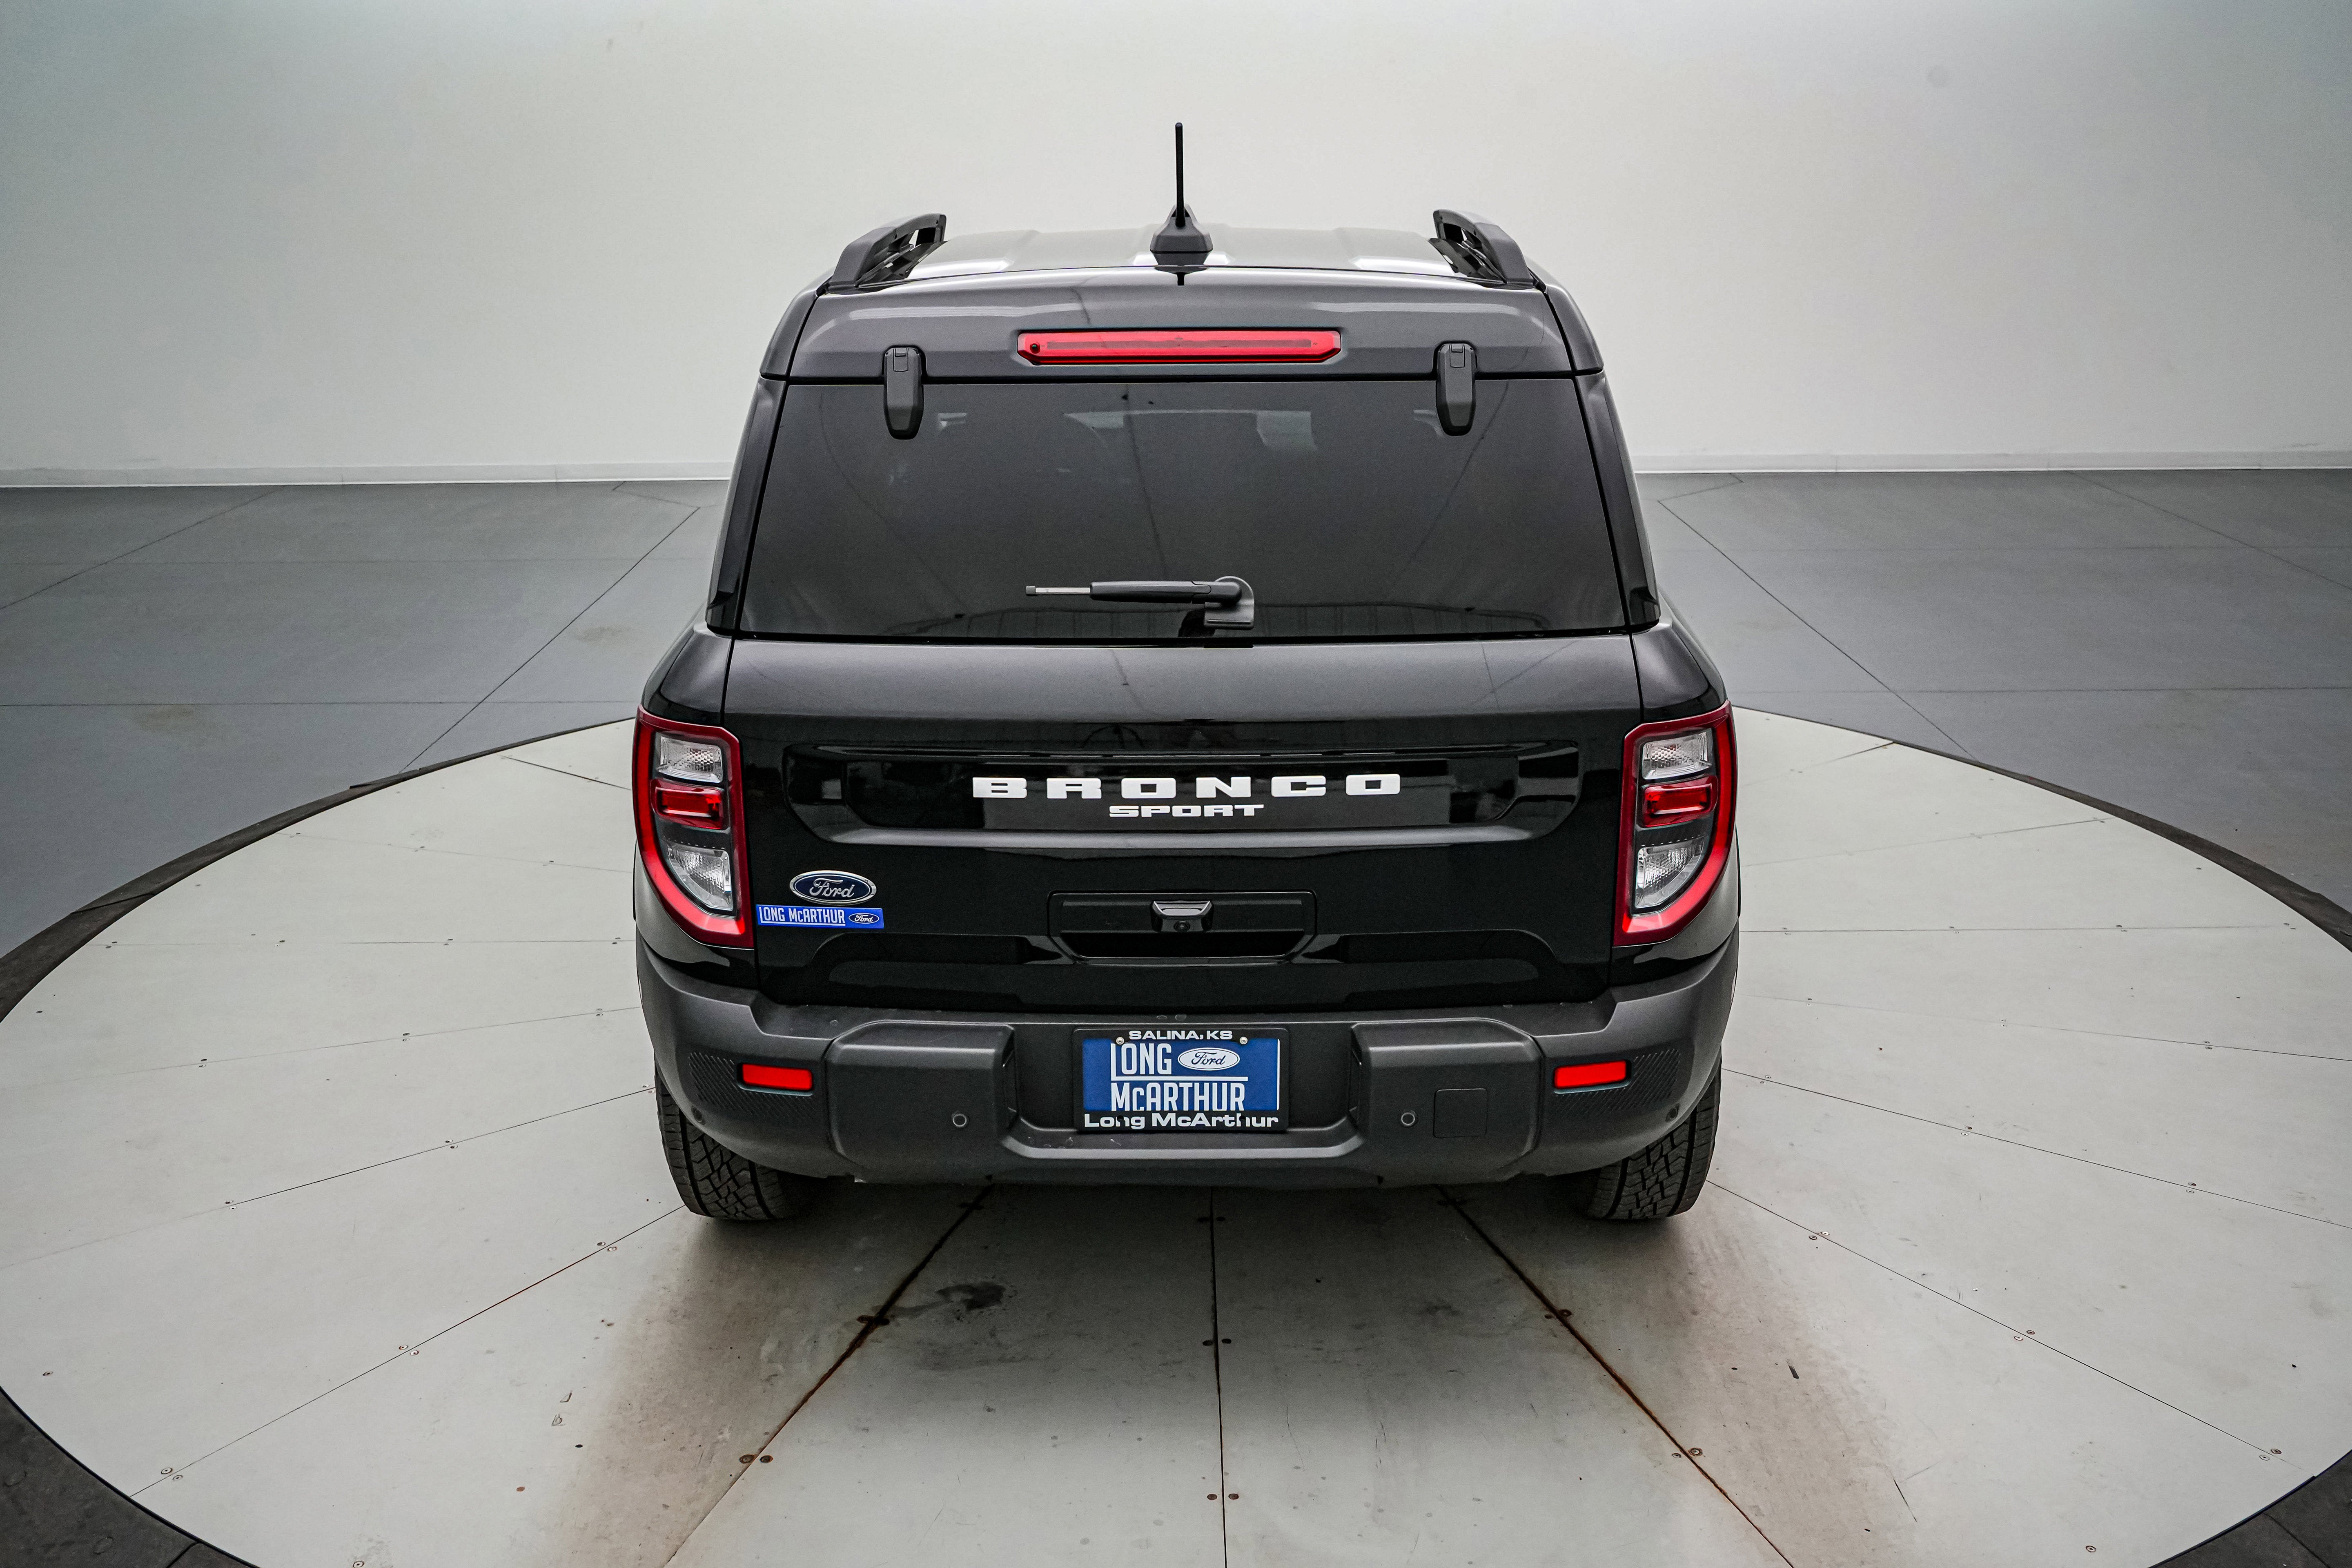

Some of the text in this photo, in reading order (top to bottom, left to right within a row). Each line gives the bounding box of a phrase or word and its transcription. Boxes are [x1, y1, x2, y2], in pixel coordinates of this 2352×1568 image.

[973, 774, 1400, 799] BRONCO
[1109, 804, 1264, 817] SPORT
[809, 878, 855, 898] Ford
[759, 906, 845, 924] LONG McARTHUR
[854, 914, 873, 922] Ford
[1110, 1043, 1172, 1080] LONG
[1191, 1051, 1226, 1065] Ford
[1111, 1082, 1245, 1111] McARTHUR
[1084, 1113, 1278, 1129] Long McArthur
